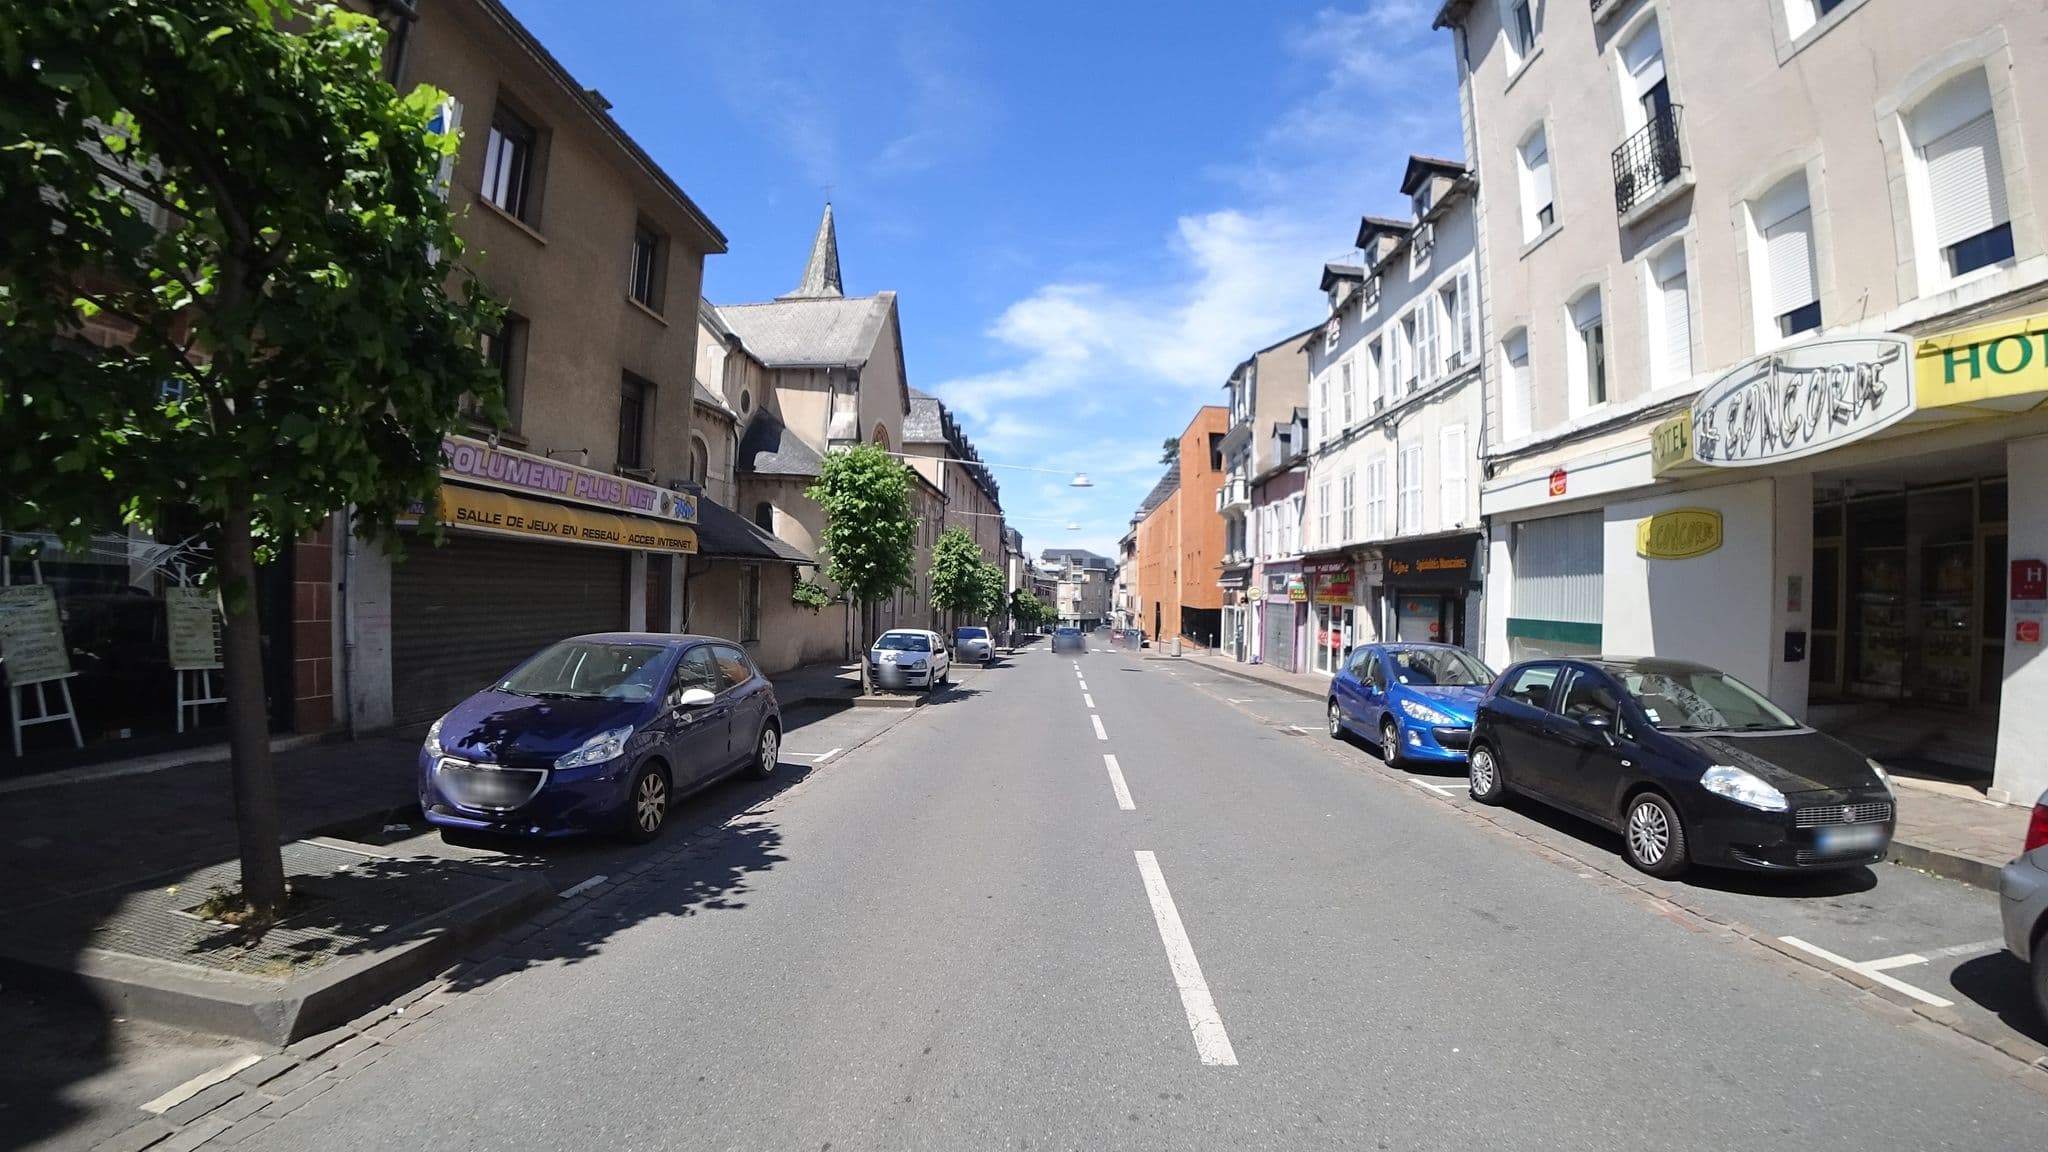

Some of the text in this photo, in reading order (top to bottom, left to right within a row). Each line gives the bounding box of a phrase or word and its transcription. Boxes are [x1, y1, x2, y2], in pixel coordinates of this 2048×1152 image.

[1726, 360, 1889, 449] CONCORDE
[574, 472, 622, 504] PLUS
[624, 484, 657, 511] NET
[456, 507, 692, 549] SALLE DE JEUX EN RESEAU ACCES INTERNET
[2027, 567, 2042, 582] H
